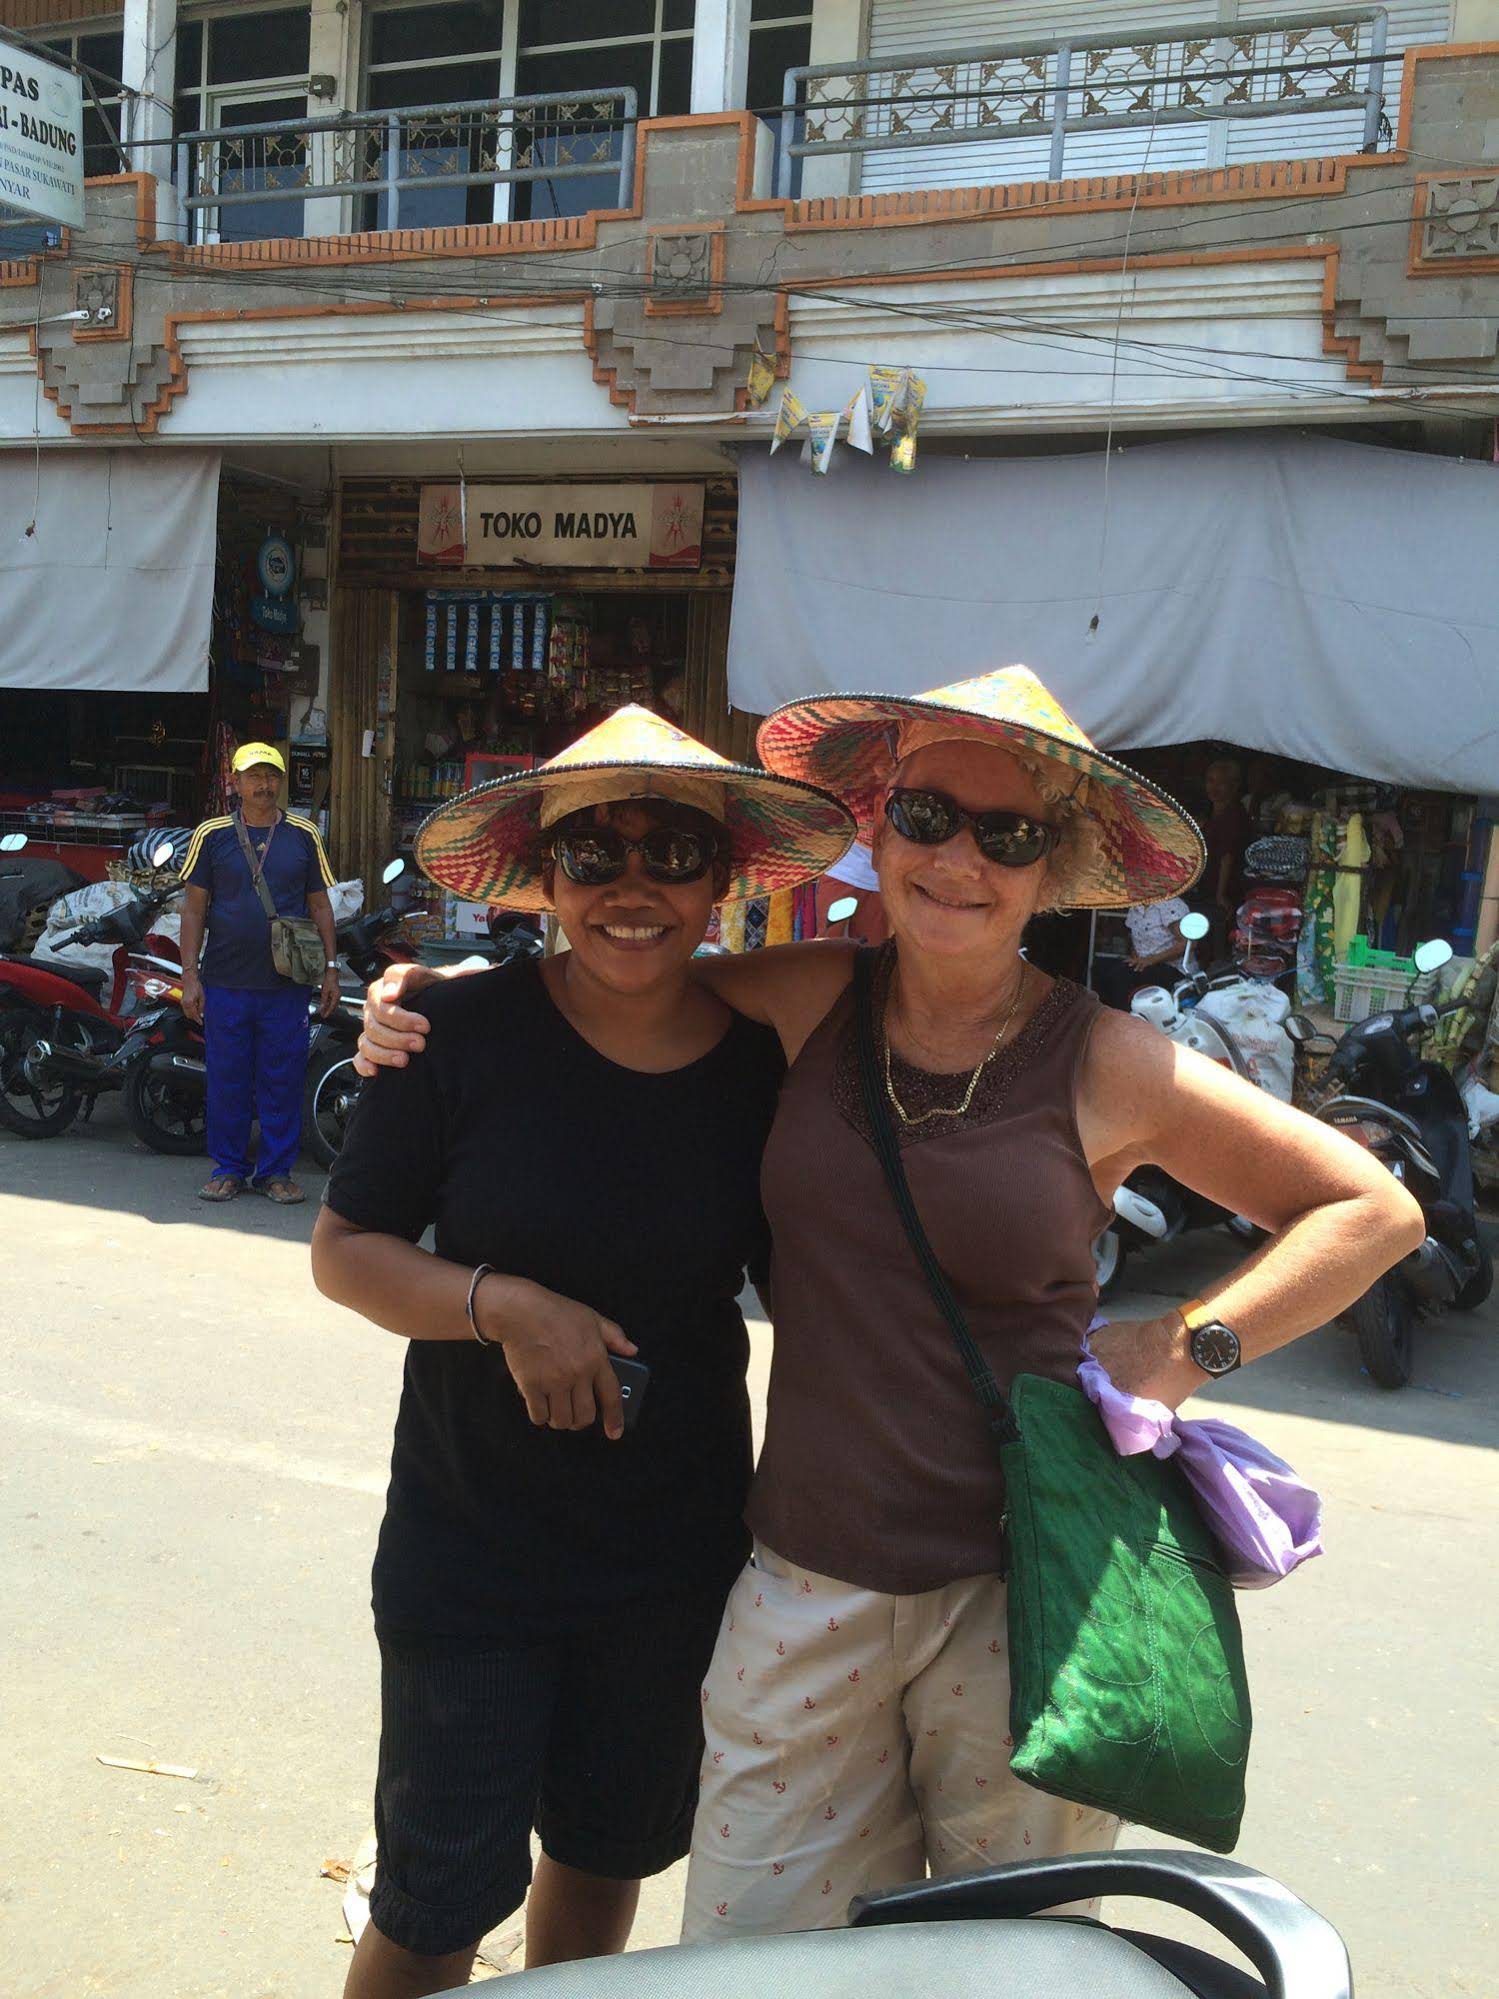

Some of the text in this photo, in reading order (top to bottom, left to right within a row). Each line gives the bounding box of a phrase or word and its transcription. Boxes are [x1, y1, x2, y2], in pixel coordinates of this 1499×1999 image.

[0, 65, 39, 102] PAS
[19, 111, 77, 156] BADUNG
[4, 158, 32, 180] PASAR
[32, 169, 75, 196] SUKAWATI
[480, 511, 542, 539] TOKO
[554, 512, 637, 539] MADYA
[1333, 1114, 1358, 1124] YAMAHA
